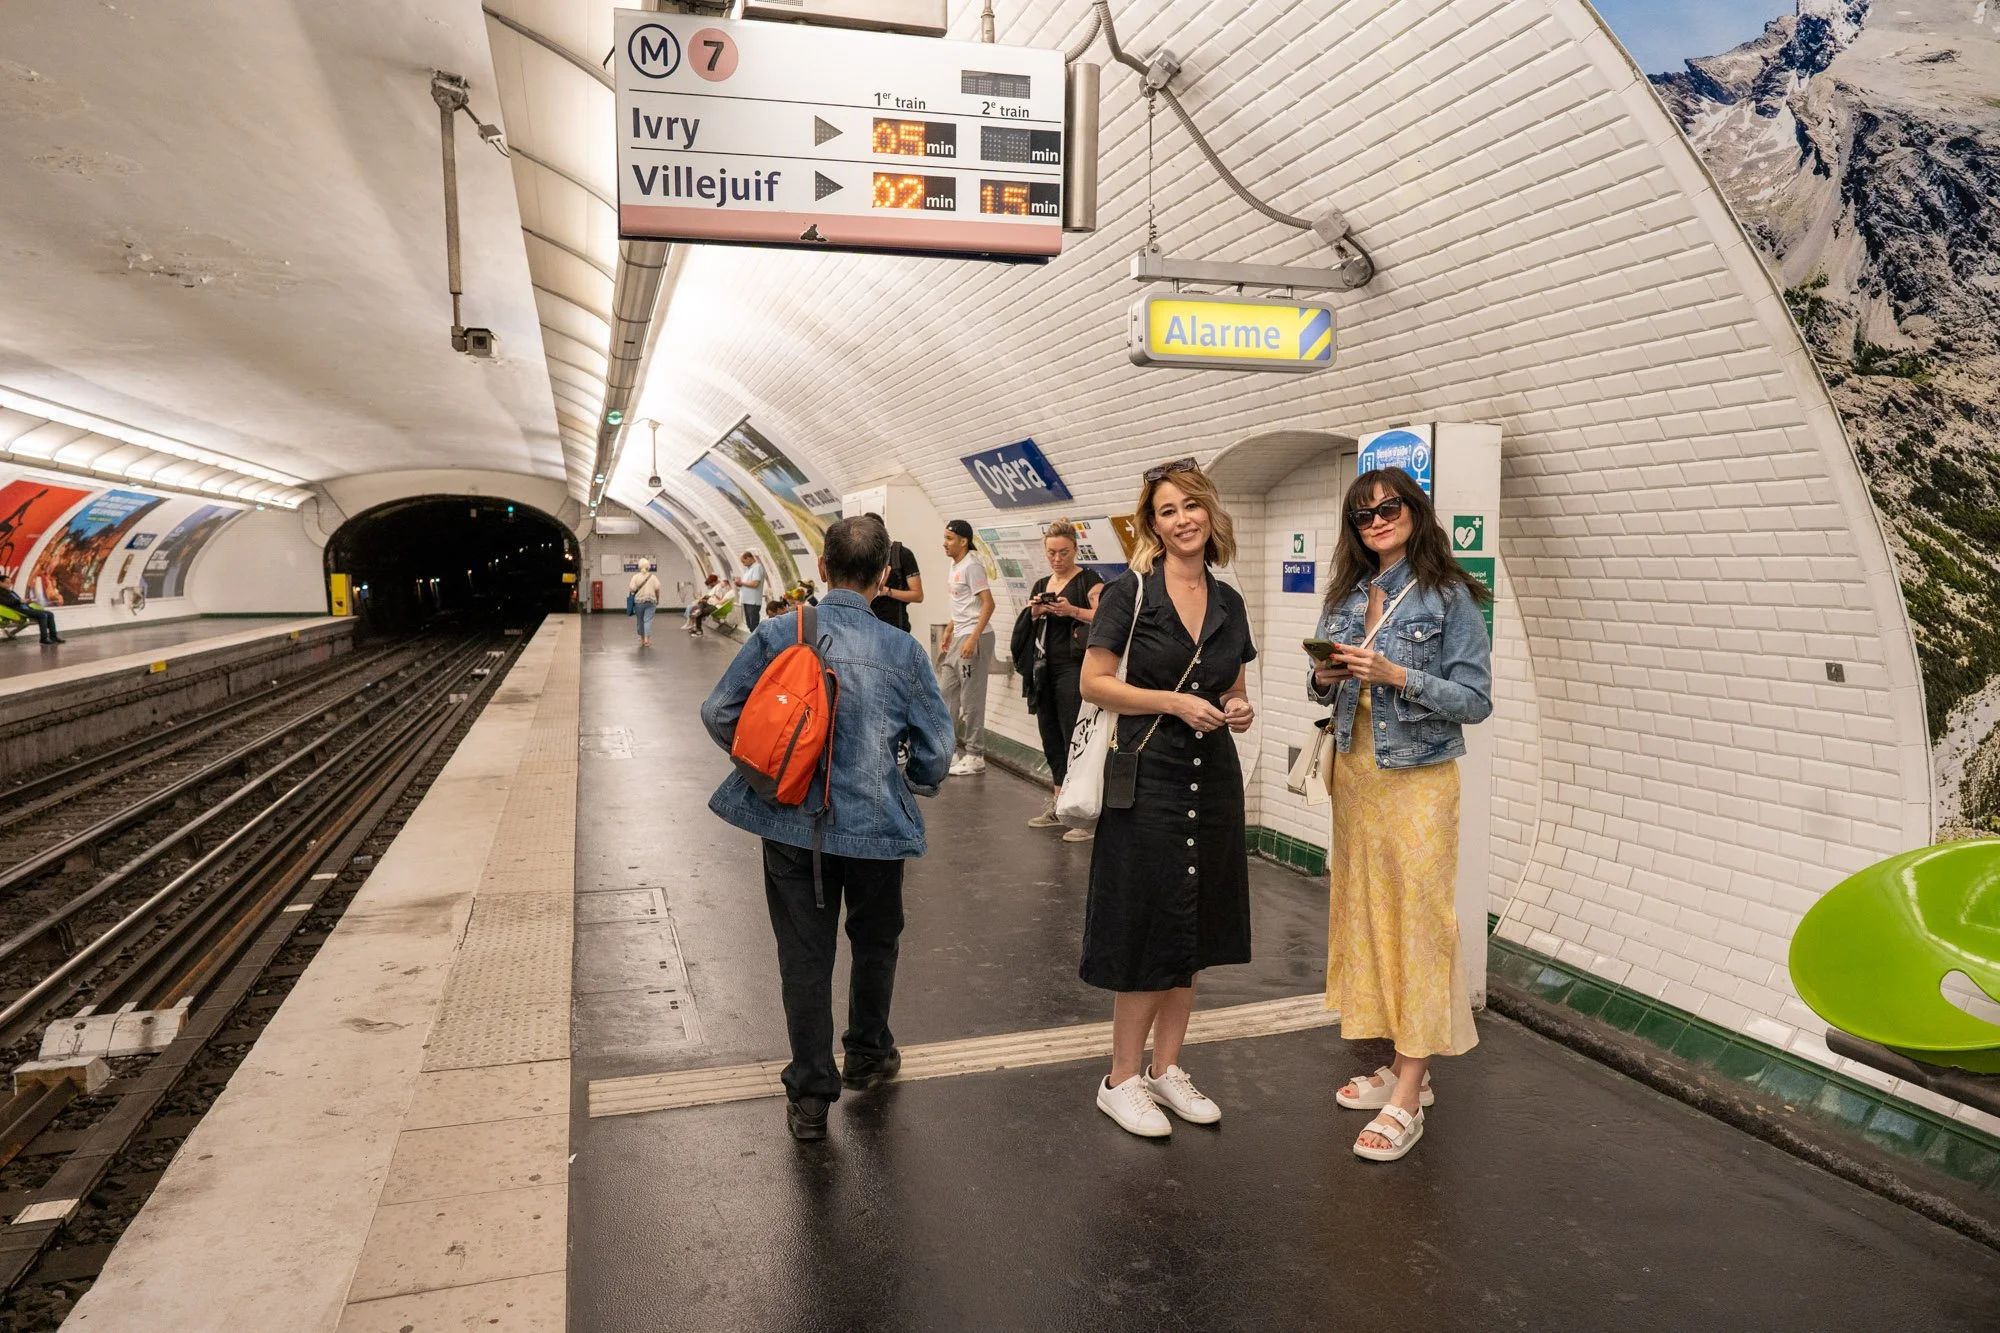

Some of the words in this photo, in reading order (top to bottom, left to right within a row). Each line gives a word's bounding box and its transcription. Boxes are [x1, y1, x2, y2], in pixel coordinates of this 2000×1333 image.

[703, 40, 725, 72] 7
[895, 96, 926, 110] train
[1000, 105, 1030, 118] train
[632, 107, 700, 150] Ivry
[873, 121, 925, 156] 05
[926, 140, 954, 155] min
[1031, 148, 1059, 162] min
[632, 164, 781, 208] Villejuif
[872, 175, 924, 209] 02
[926, 194, 954, 208] min
[982, 185, 1027, 216] 15
[1031, 201, 1058, 214] min
[1164, 315, 1281, 350] Alarme
[973, 452, 1047, 502] Opéra
[1284, 564, 1301, 574] Sortie
[962, 664, 972, 678] N
